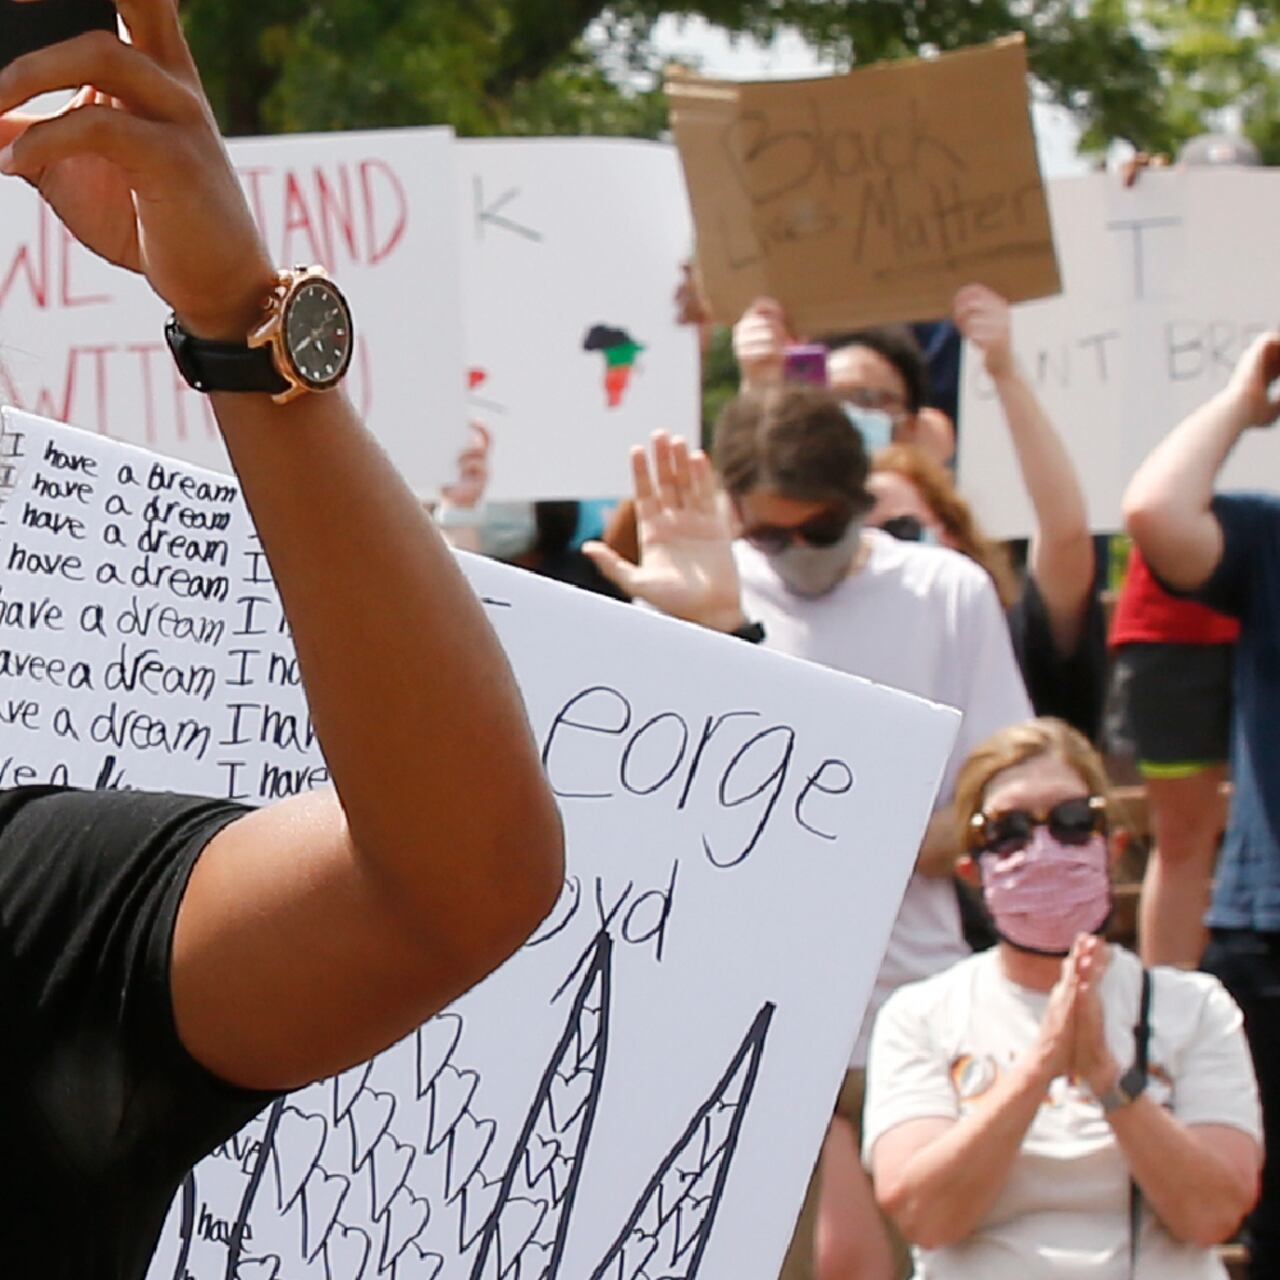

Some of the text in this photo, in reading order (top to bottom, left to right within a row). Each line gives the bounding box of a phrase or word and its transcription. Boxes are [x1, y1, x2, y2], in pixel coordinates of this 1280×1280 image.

[239, 158, 410, 273] TAND
[1, 433, 25, 457] I
[44, 440, 98, 477] have
[118, 465, 139, 486] a
[32, 473, 95, 504] have
[105, 495, 133, 516] a
[143, 496, 232, 531] dream
[22, 502, 87, 539] have
[103, 524, 127, 548] a
[138, 520, 229, 567] dream
[7, 542, 86, 581] have
[96, 563, 127, 586] a
[131, 555, 230, 602] dream
[80, 603, 108, 637] a
[117, 596, 225, 646] dream
[232, 596, 273, 636] I
[104, 642, 217, 701] dream
[225, 649, 262, 686] I
[53, 707, 80, 741] a
[90, 702, 211, 761] dream
[219, 703, 262, 745] I
[217, 761, 252, 800] I
[259, 761, 329, 799] have
[542, 684, 855, 868] eorge
[523, 859, 680, 1004] oyd
[210, 1132, 266, 1176] ave
